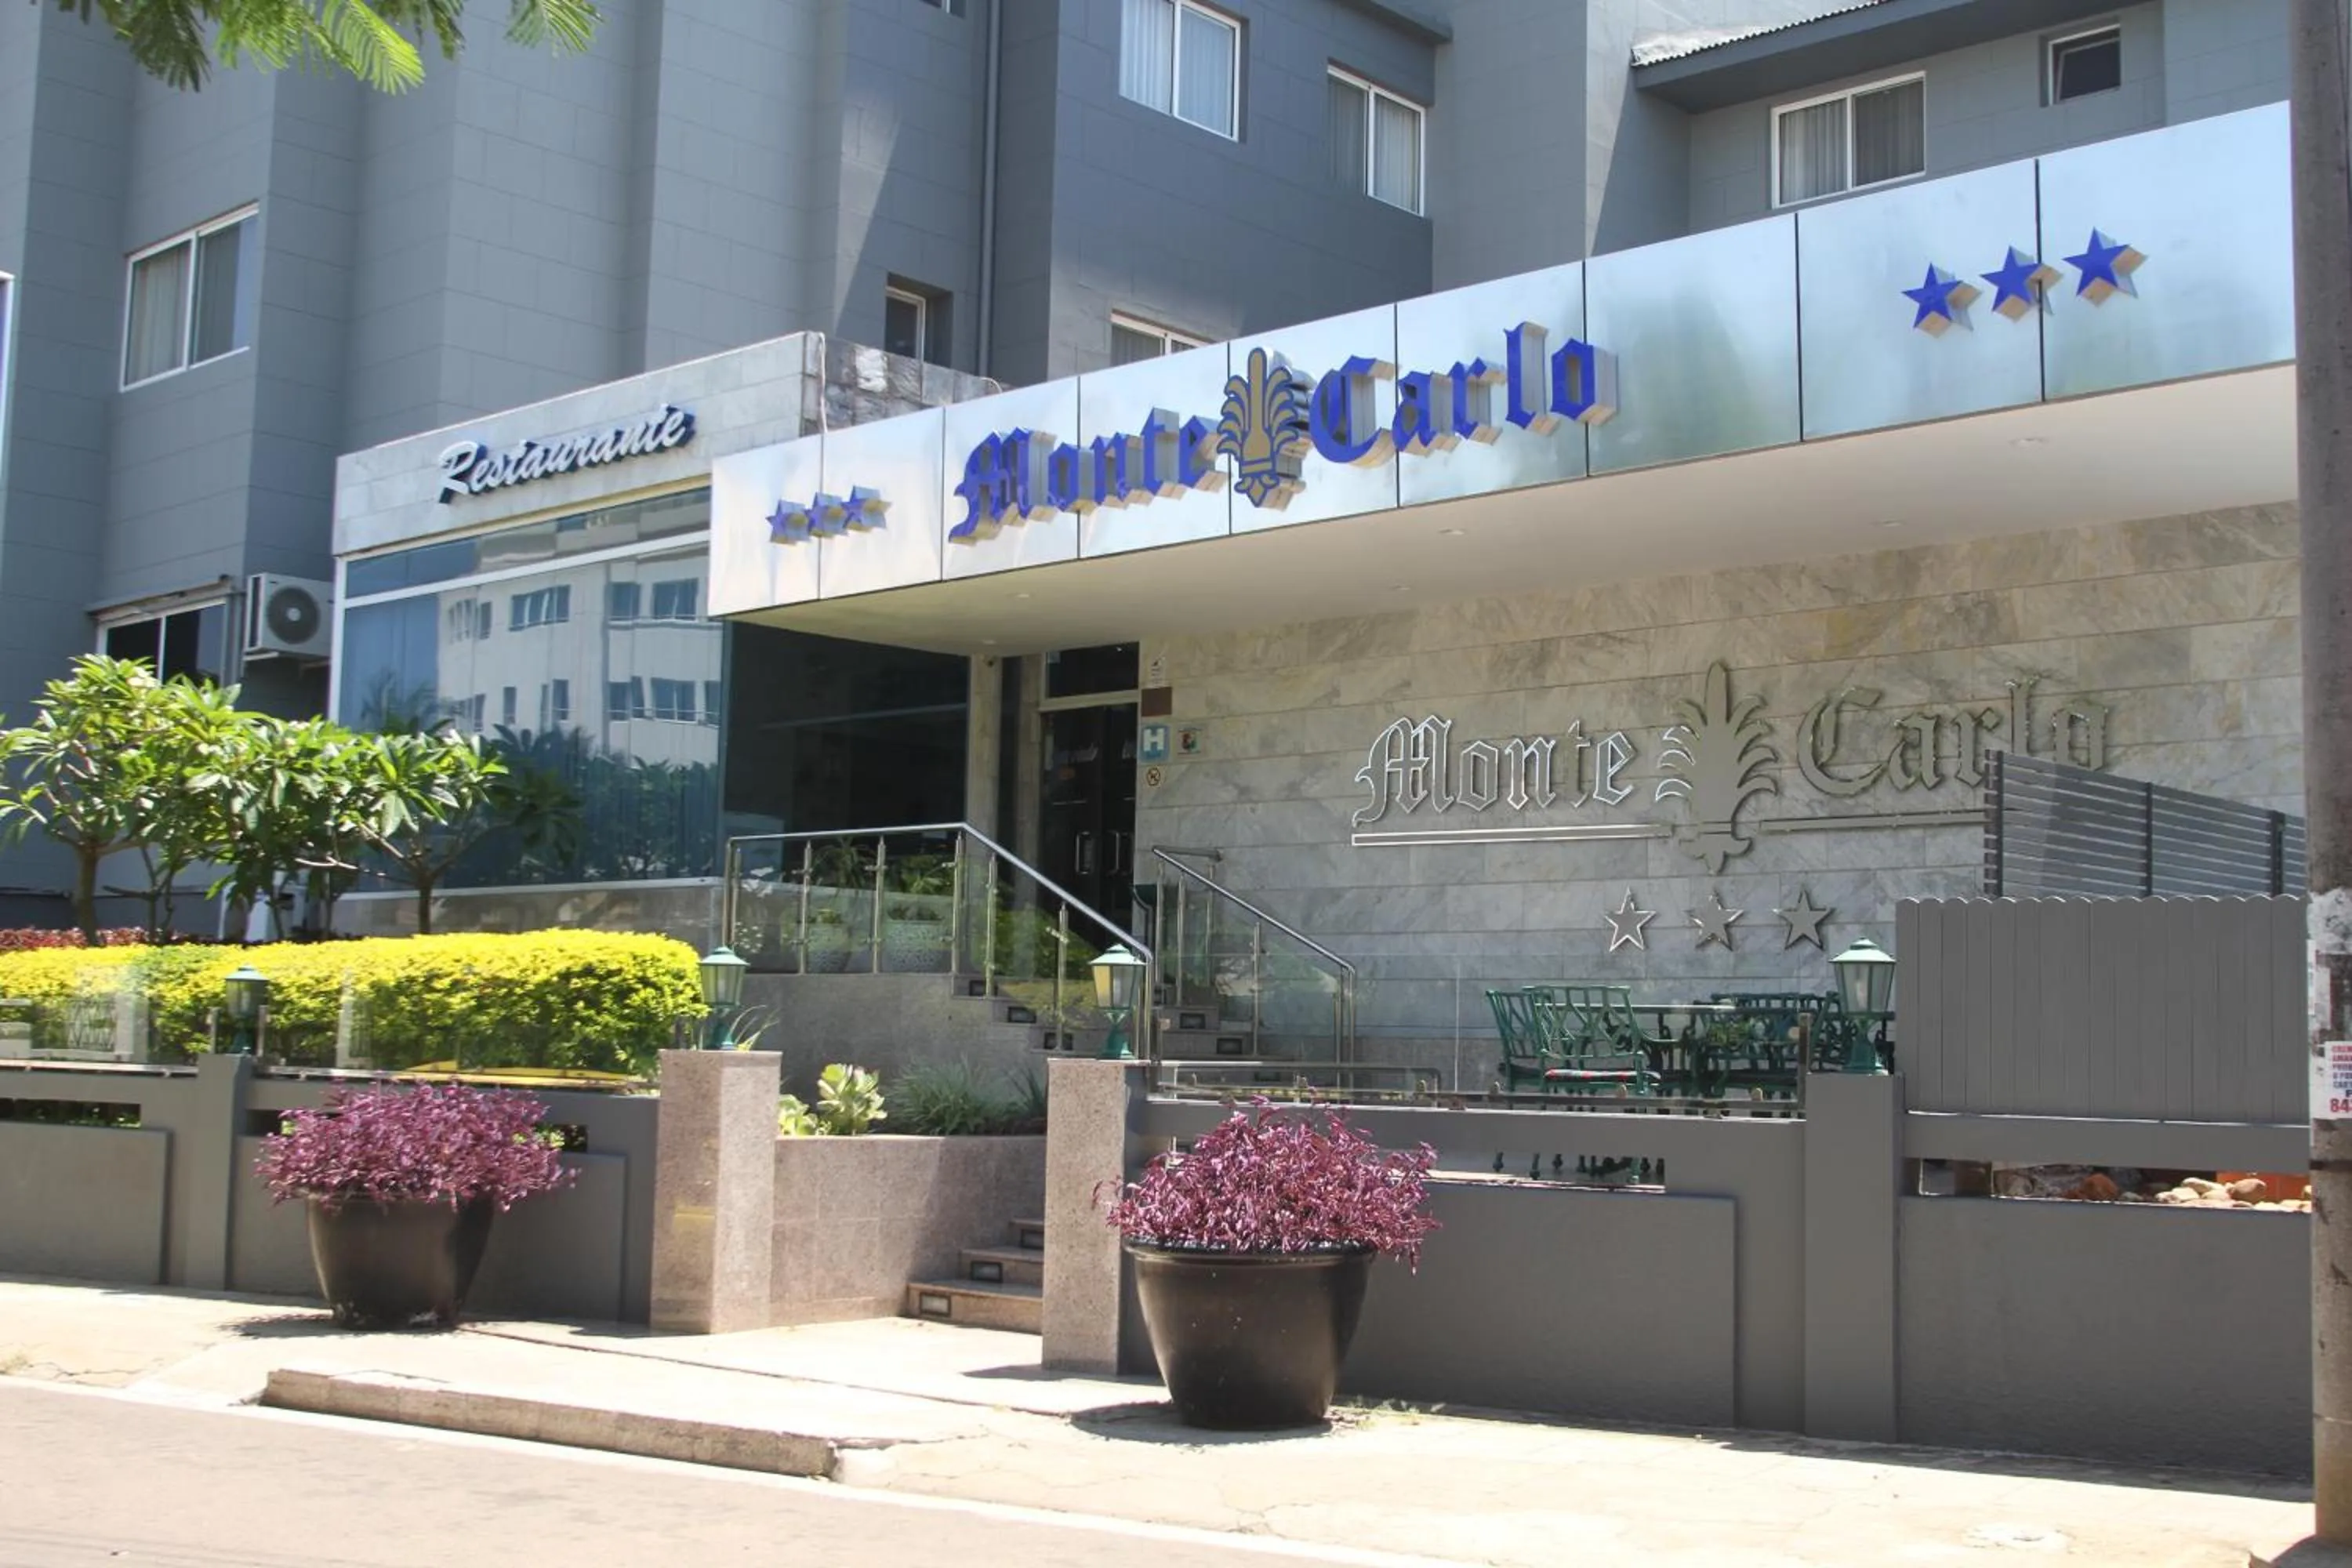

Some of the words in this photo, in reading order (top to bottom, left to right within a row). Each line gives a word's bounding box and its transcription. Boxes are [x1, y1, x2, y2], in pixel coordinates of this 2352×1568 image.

[437, 402, 695, 503] Restaurante
[949, 408, 1225, 544] Monte
[1309, 321, 1618, 468] Carlo
[1144, 728, 1164, 752] H
[1352, 715, 1637, 827] Monte
[1797, 679, 2106, 798] Carlo
